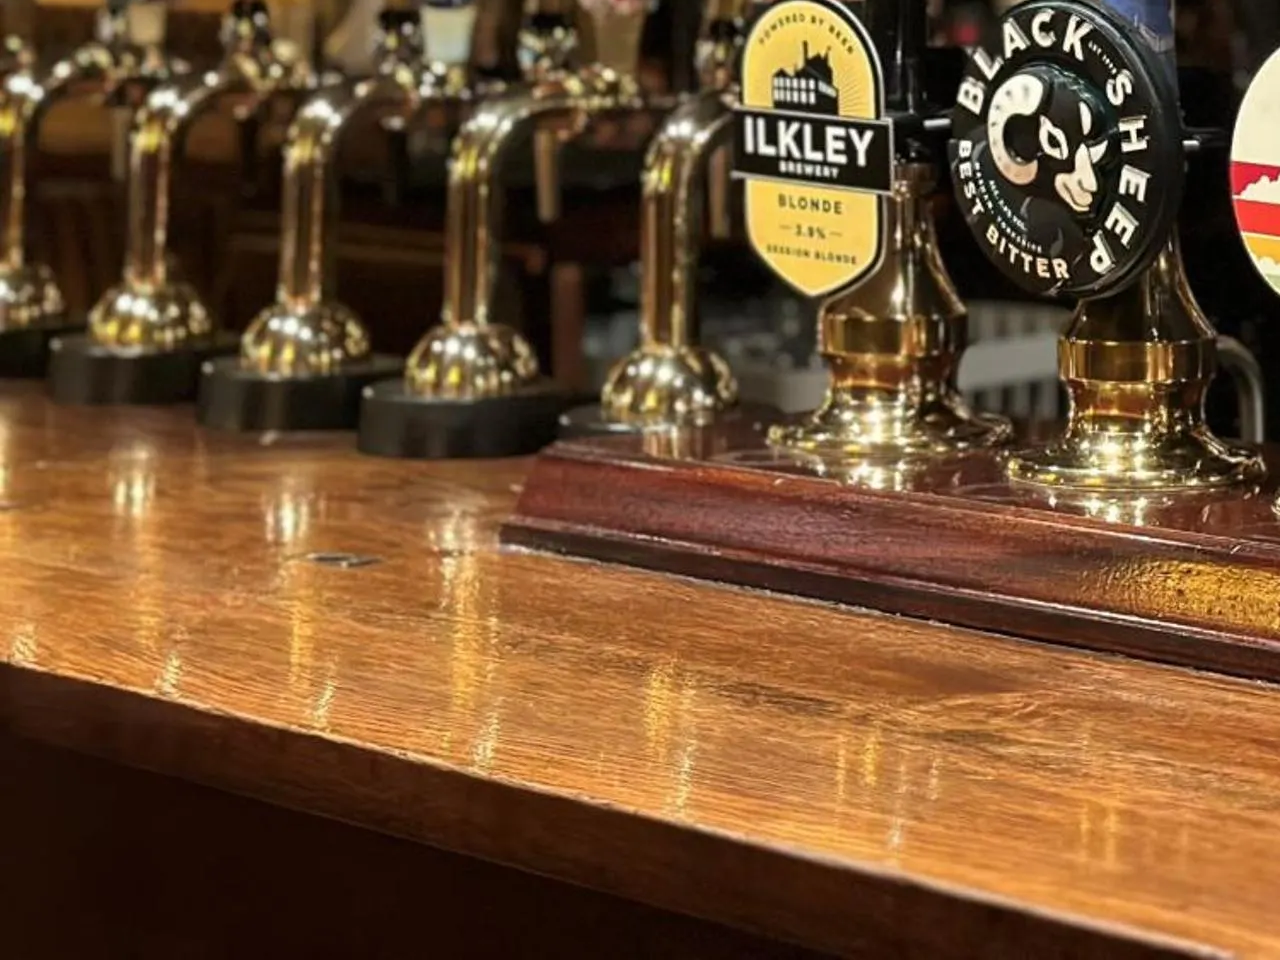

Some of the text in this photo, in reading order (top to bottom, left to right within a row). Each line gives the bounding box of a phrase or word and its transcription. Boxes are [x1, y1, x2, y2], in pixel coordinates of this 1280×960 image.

[744, 115, 874, 168] ILKLEY
[955, 7, 1152, 276] BLACK SHEEP
[779, 160, 840, 179] BREWERY
[778, 192, 843, 216] BLONDE
[958, 139, 1070, 280] BEST BITTER
